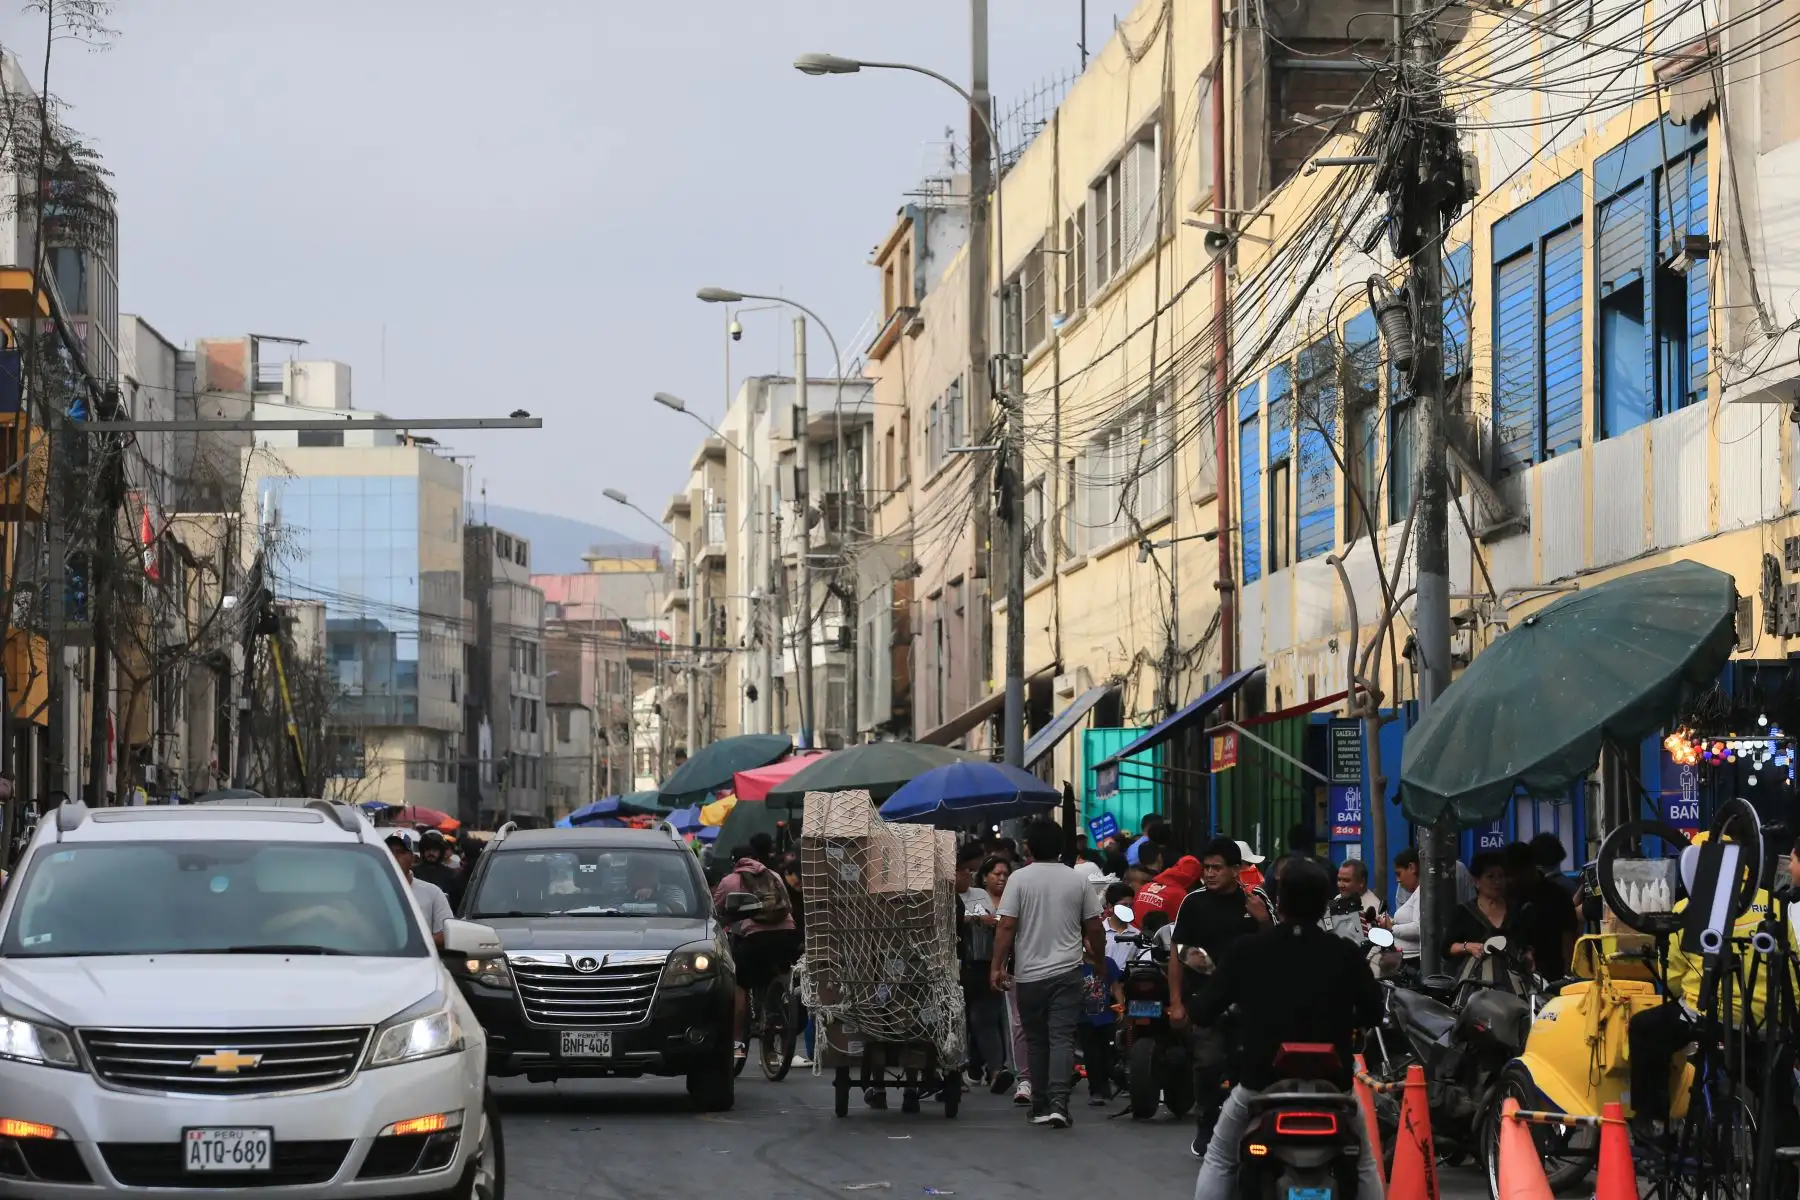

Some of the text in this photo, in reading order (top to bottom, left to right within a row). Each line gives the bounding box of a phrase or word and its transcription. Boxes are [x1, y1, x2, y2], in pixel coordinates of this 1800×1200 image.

[1335, 826, 1354, 834] 2do
[563, 1039, 609, 1053] BNH-406
[214, 1131, 244, 1140] PERU
[190, 1140, 267, 1164] ATQ-689
